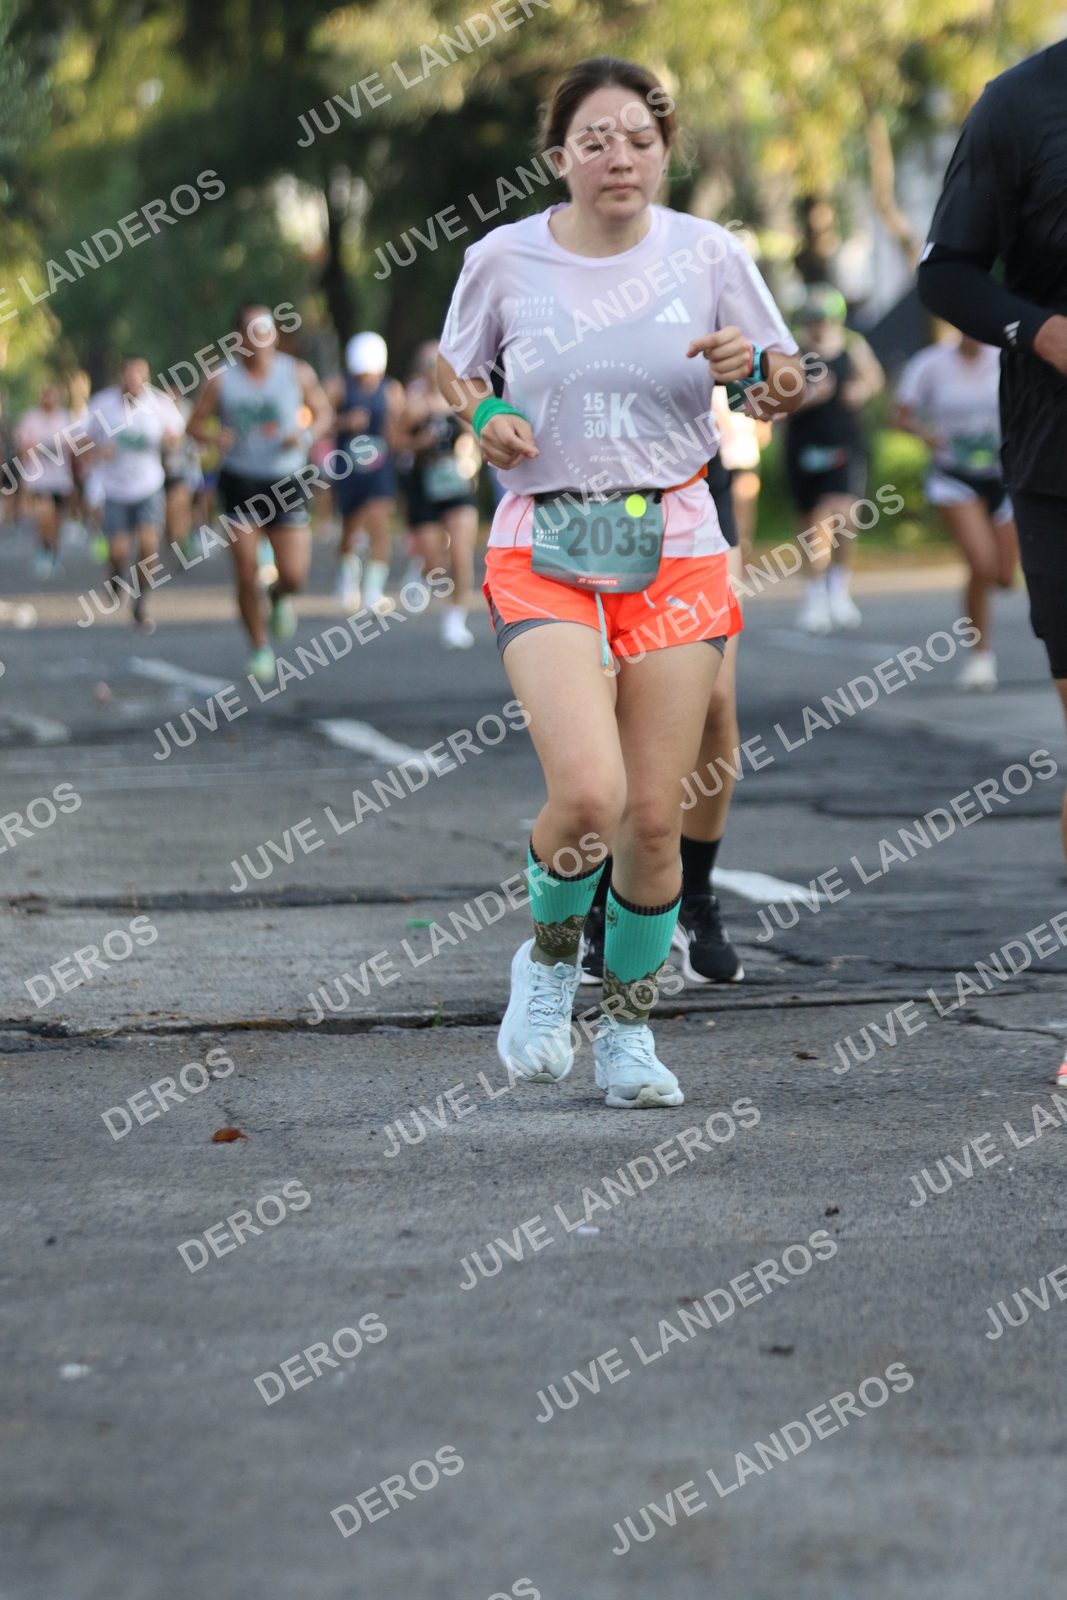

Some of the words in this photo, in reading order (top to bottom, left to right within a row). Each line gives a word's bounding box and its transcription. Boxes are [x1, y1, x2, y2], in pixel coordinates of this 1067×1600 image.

[583, 392, 605, 412] 15
[610, 392, 639, 439] K
[583, 419, 606, 439] 30
[566, 516, 659, 558] 2035
